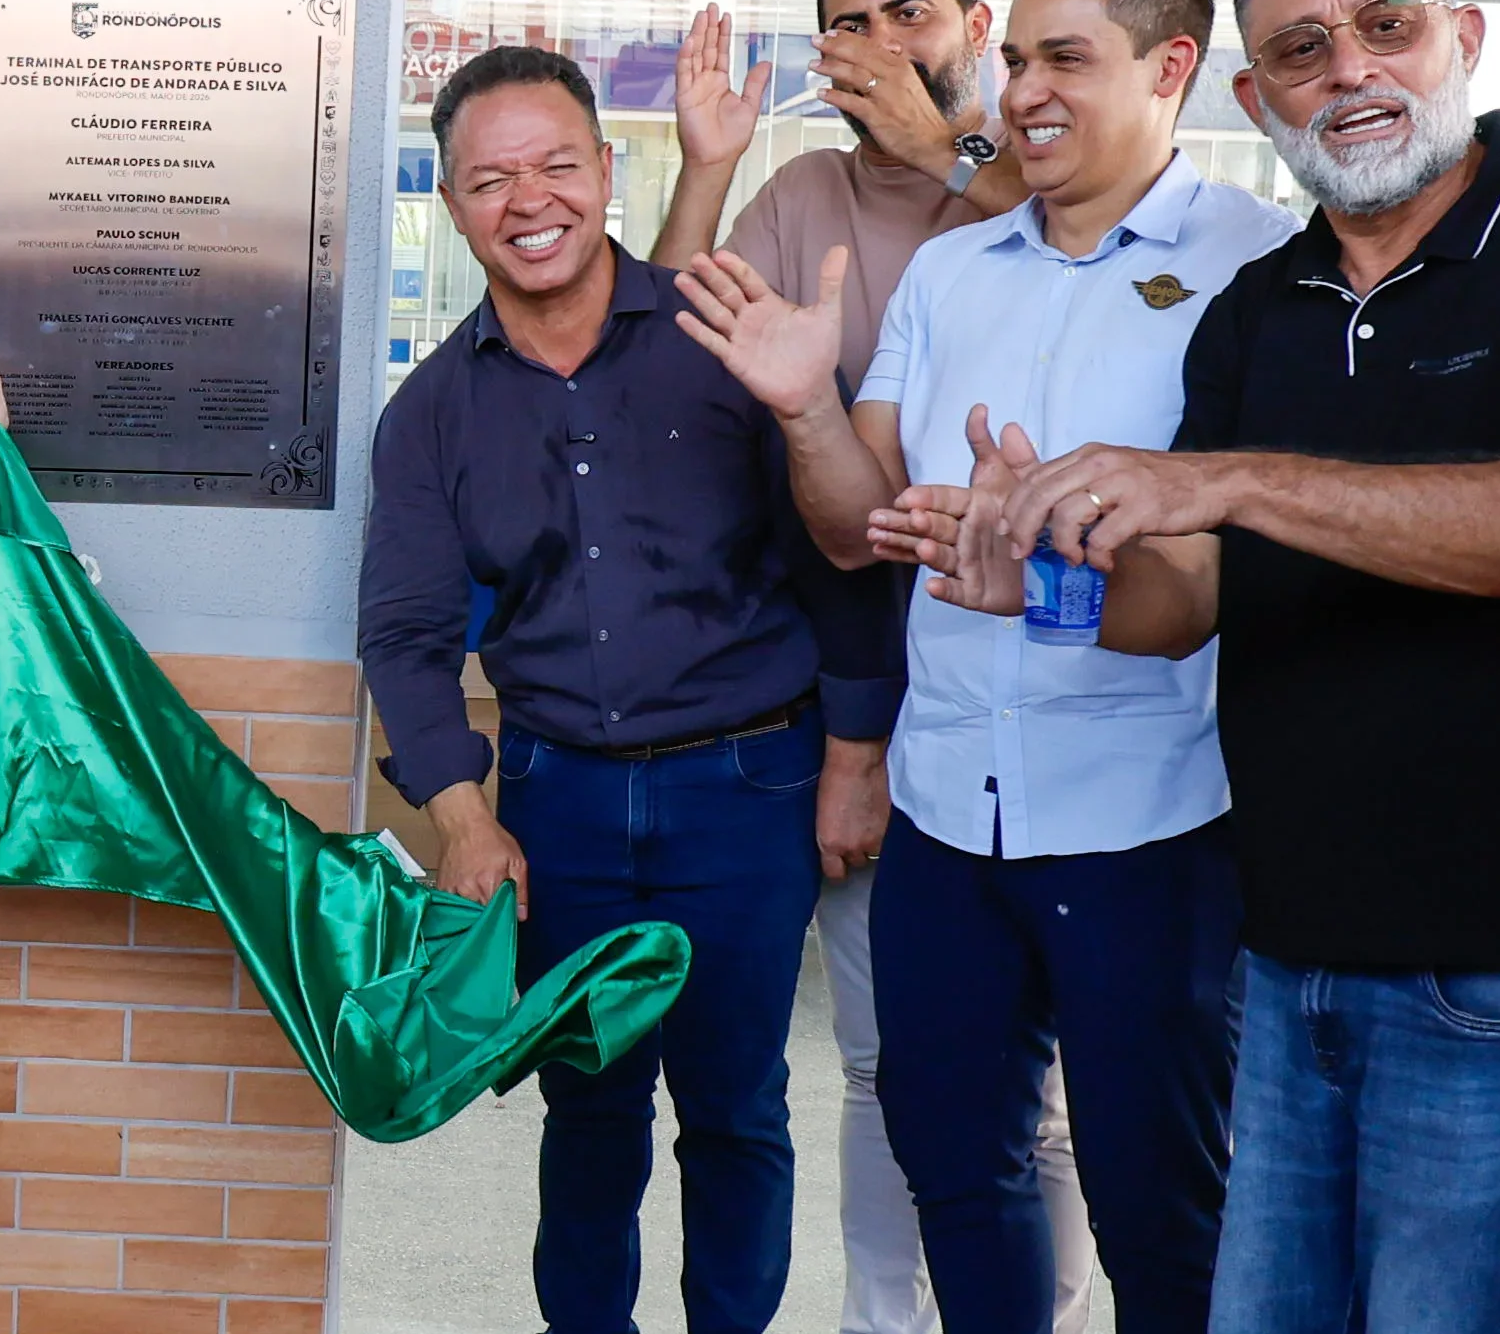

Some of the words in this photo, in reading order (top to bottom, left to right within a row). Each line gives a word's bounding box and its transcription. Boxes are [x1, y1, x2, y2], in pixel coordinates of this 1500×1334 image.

[102, 13, 222, 28] RONDONÓPOLIS
[7, 56, 83, 69] TERMINAL
[87, 58, 107, 70] DE
[111, 59, 212, 72] TRANSPORTE
[216, 58, 283, 74] PÚBLICO
[0, 71, 38, 86] JOSÉ
[43, 72, 126, 88] BONIFÁCIO
[130, 78, 150, 89] DE
[153, 78, 230, 91] ANDRADA
[234, 80, 242, 91] E
[246, 80, 288, 93] SILVA
[175, 93, 187, 101] DE
[71, 114, 137, 130] CLÁUDIO
[141, 119, 213, 132] FERREIRA
[96, 133, 137, 142] PREFEITO
[138, 134, 186, 143] MUNICIPAL
[65, 156, 121, 167] ALTEMAR
[123, 157, 160, 168] LOPES
[164, 158, 180, 168] DA
[183, 158, 216, 170] SILVA
[49, 191, 103, 203] MYKAELL
[107, 193, 166, 204] VITORINO
[169, 194, 231, 206] BANDEIRA
[97, 229, 136, 240] PAULO
[138, 230, 180, 241] SCHUH
[72, 265, 110, 276] LUCAS
[113, 266, 177, 277] CORRENTE
[179, 267, 201, 278] LUZ
[38, 312, 82, 323] THALES
[112, 314, 182, 327] GONÇALVES
[185, 316, 235, 328] VICENTE
[94, 360, 174, 372] VEREADORES
